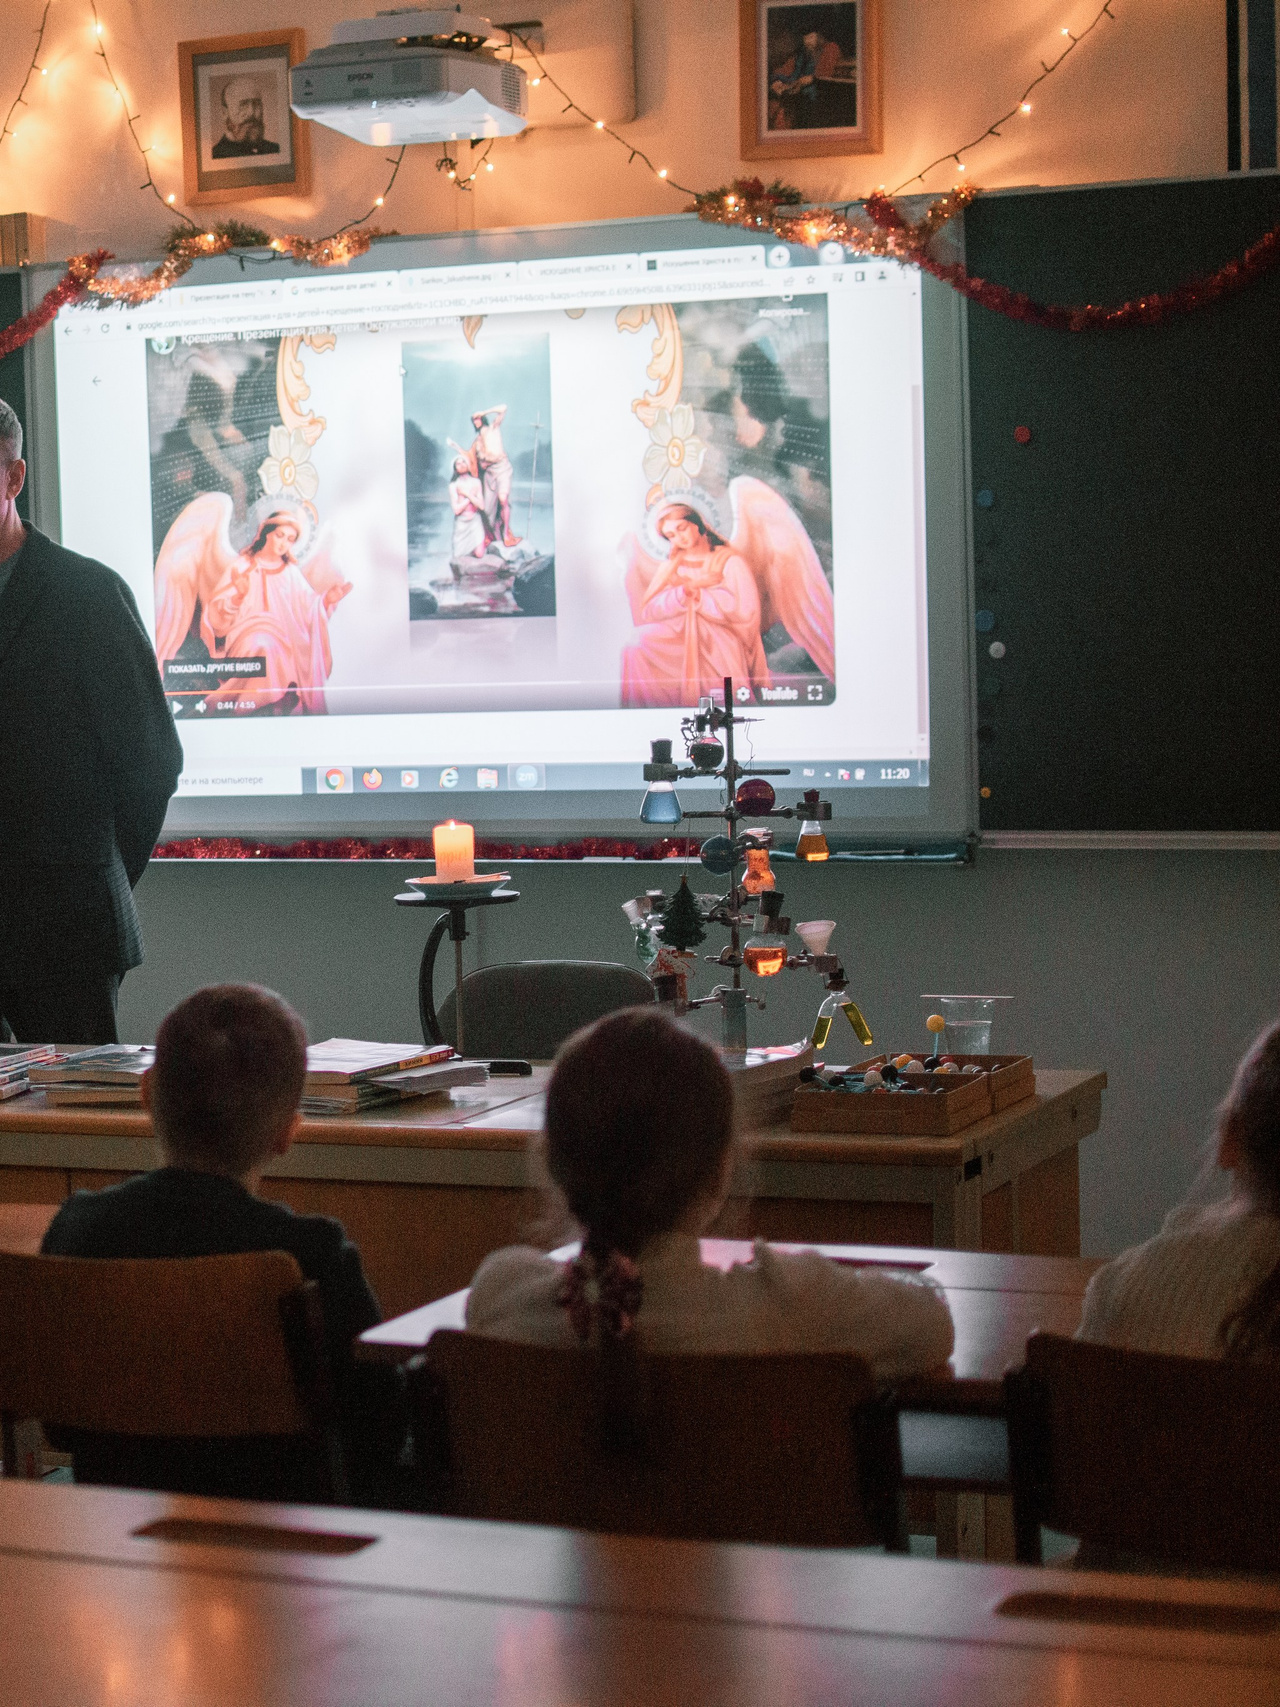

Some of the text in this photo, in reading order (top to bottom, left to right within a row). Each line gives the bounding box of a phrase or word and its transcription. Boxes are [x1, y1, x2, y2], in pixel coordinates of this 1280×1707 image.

[238, 326, 306, 342] Презентация
[308, 325, 328, 335] для
[168, 662, 261, 674] ПОКАЗАТЬ ДРУГИЕ ВИДЕО
[761, 686, 798, 700] YouTube
[217, 702, 234, 710] 0:44
[240, 700, 256, 709] 4:55
[880, 768, 910, 780] 11:20
[212, 776, 264, 786] компьютере
